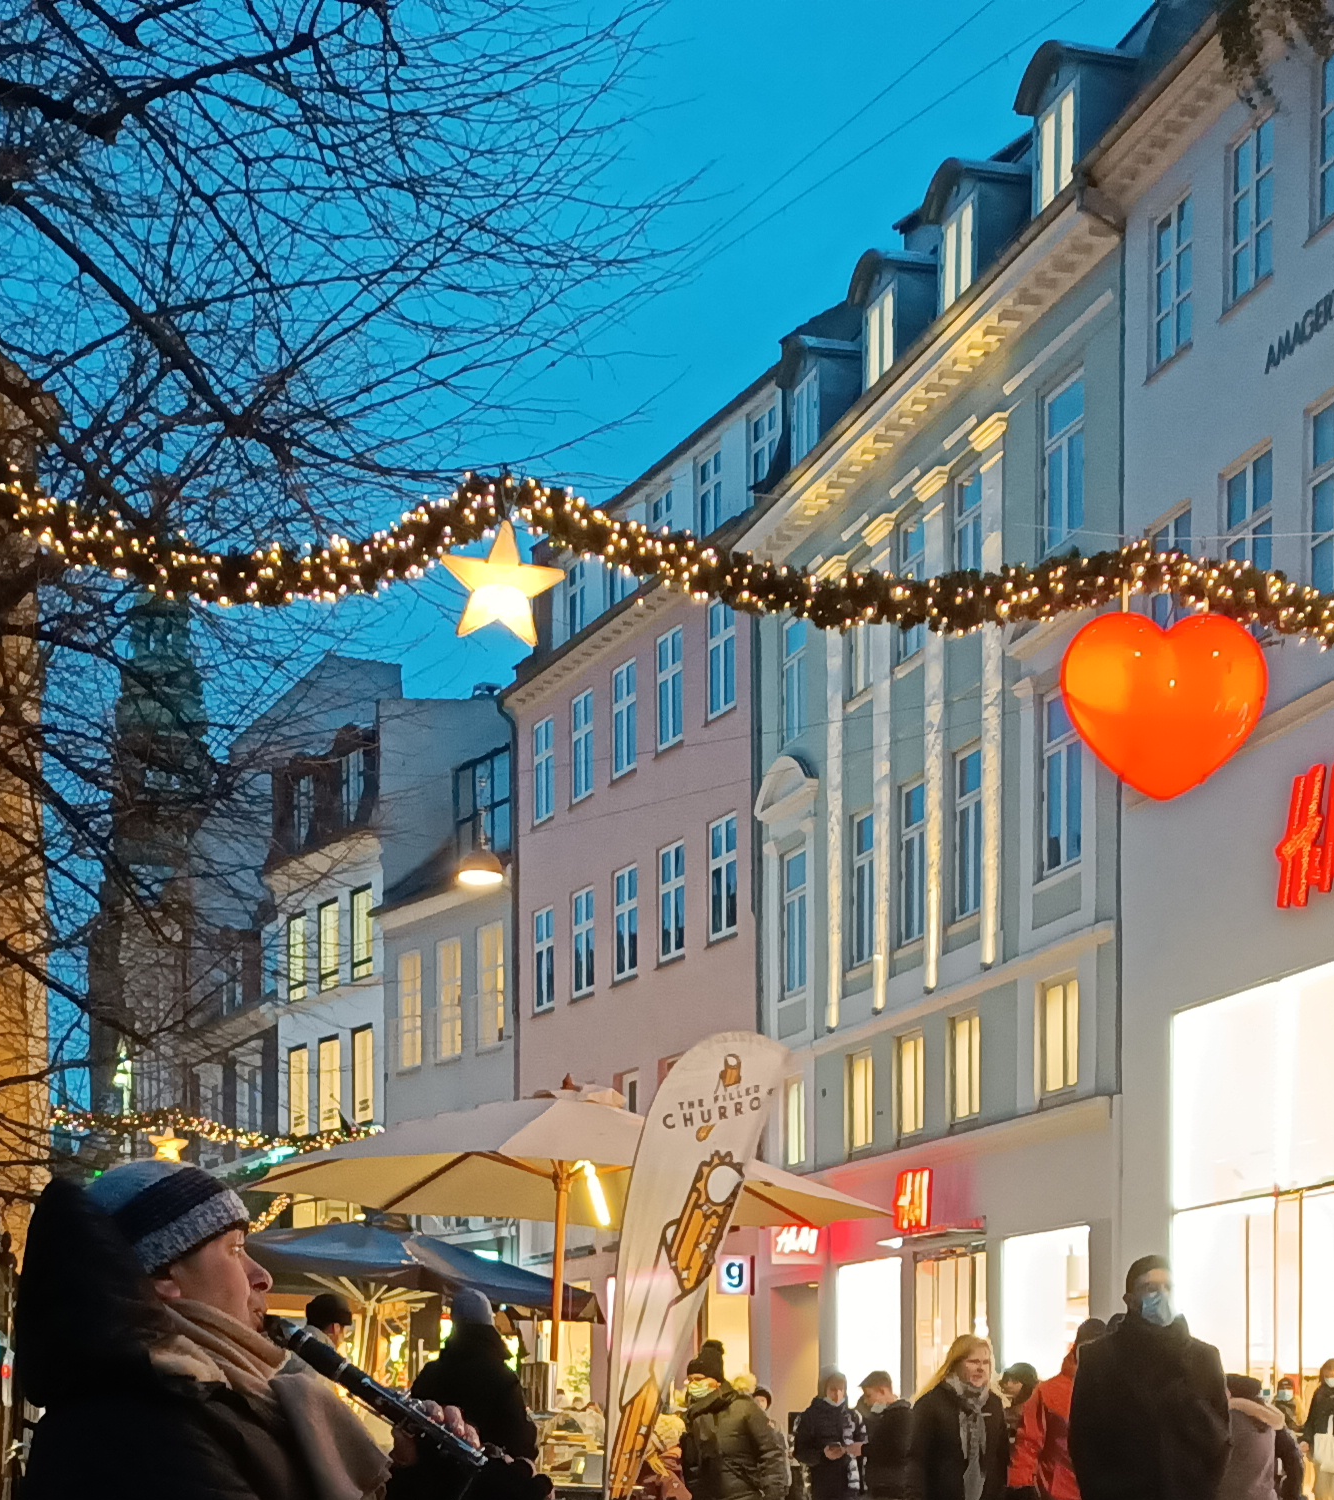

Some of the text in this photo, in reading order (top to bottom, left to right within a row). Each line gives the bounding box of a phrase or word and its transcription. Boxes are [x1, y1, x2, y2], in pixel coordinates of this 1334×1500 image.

[662, 1096, 762, 1130] CHURRO
[677, 1098, 705, 1111] THE
[775, 1224, 819, 1255] H&M
[725, 1261, 744, 1288] g
